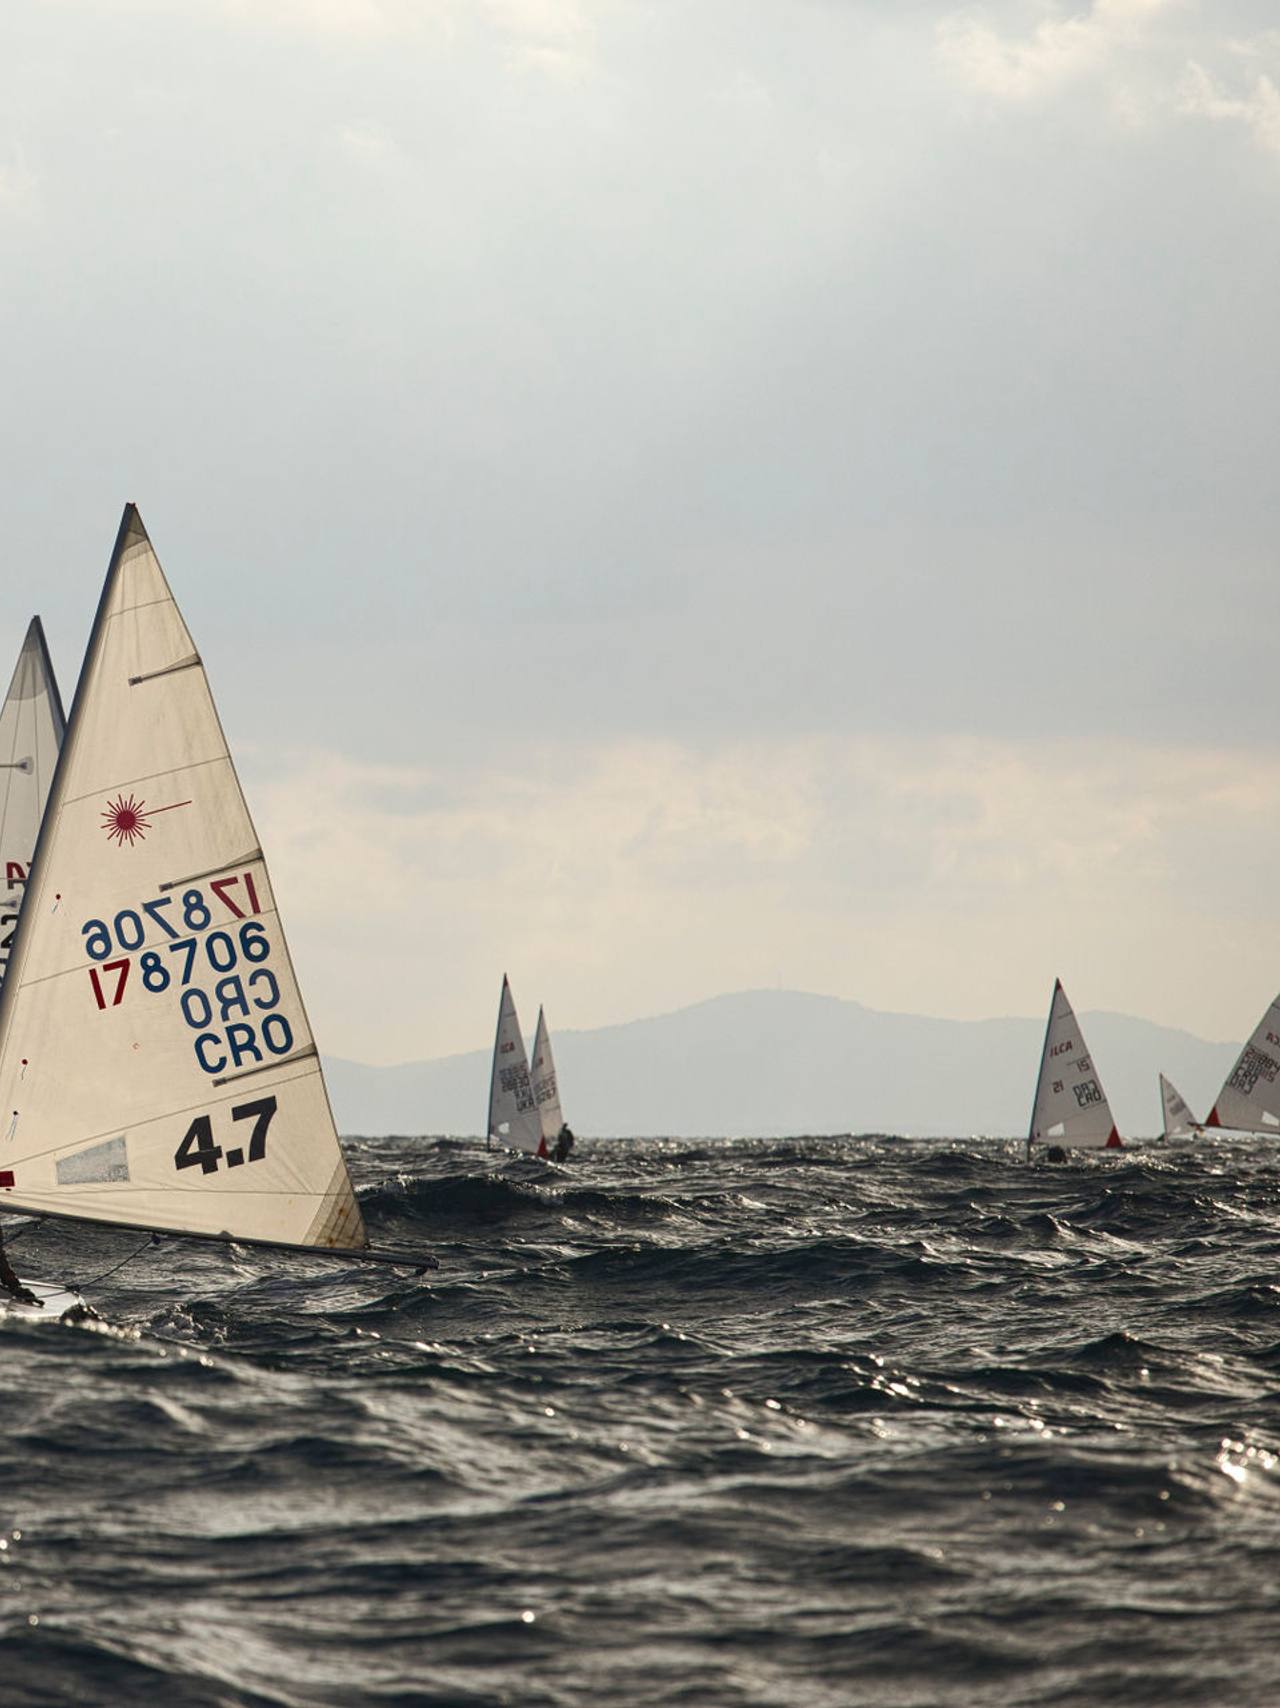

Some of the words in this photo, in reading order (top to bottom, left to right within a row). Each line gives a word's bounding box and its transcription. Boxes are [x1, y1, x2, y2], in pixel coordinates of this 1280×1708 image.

[88, 921, 271, 1010] 178706
[193, 1013, 294, 1074] CRO
[1049, 1040, 1073, 1057] ILCA
[174, 1095, 277, 1175] 4.7
